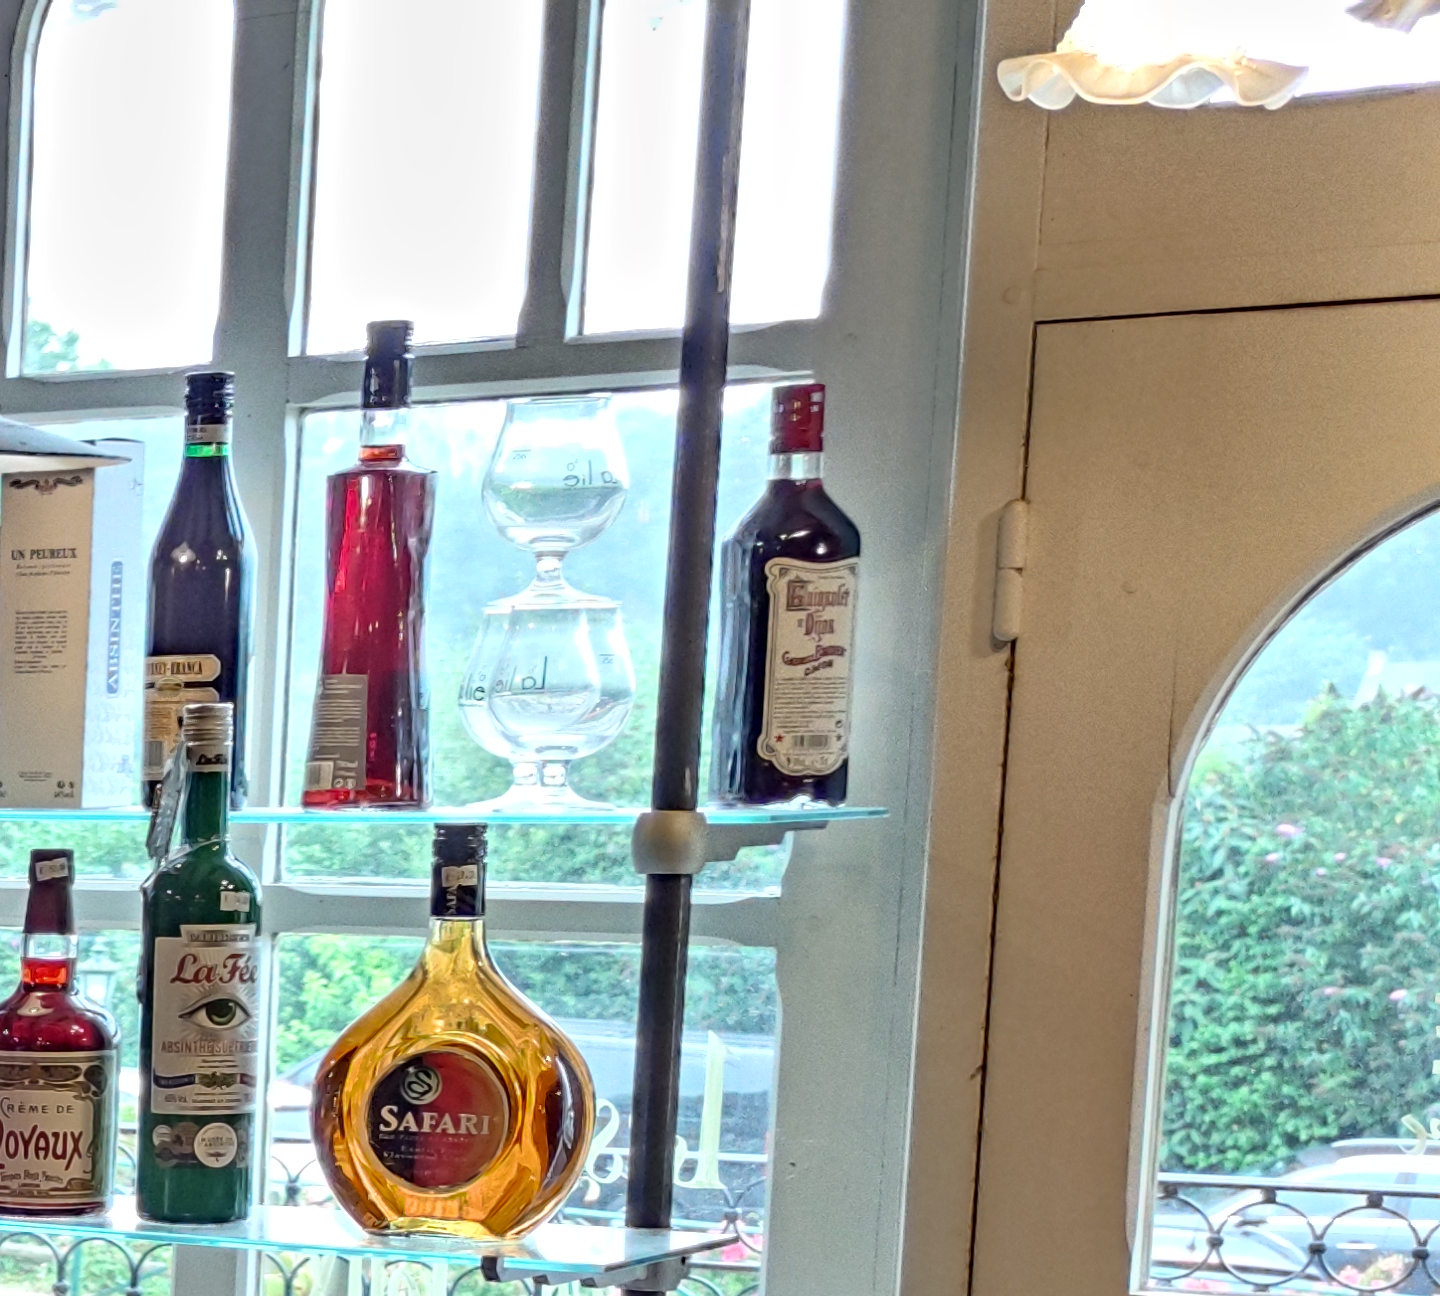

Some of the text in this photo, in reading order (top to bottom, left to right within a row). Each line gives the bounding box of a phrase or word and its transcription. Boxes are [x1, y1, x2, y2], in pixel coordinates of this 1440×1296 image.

[11, 549, 26, 561] UN
[107, 561, 123, 693] ABSINTHE
[169, 953, 218, 985] La
[0, 1096, 75, 1119] CRÈME DE
[379, 1104, 490, 1136] SAFARI
